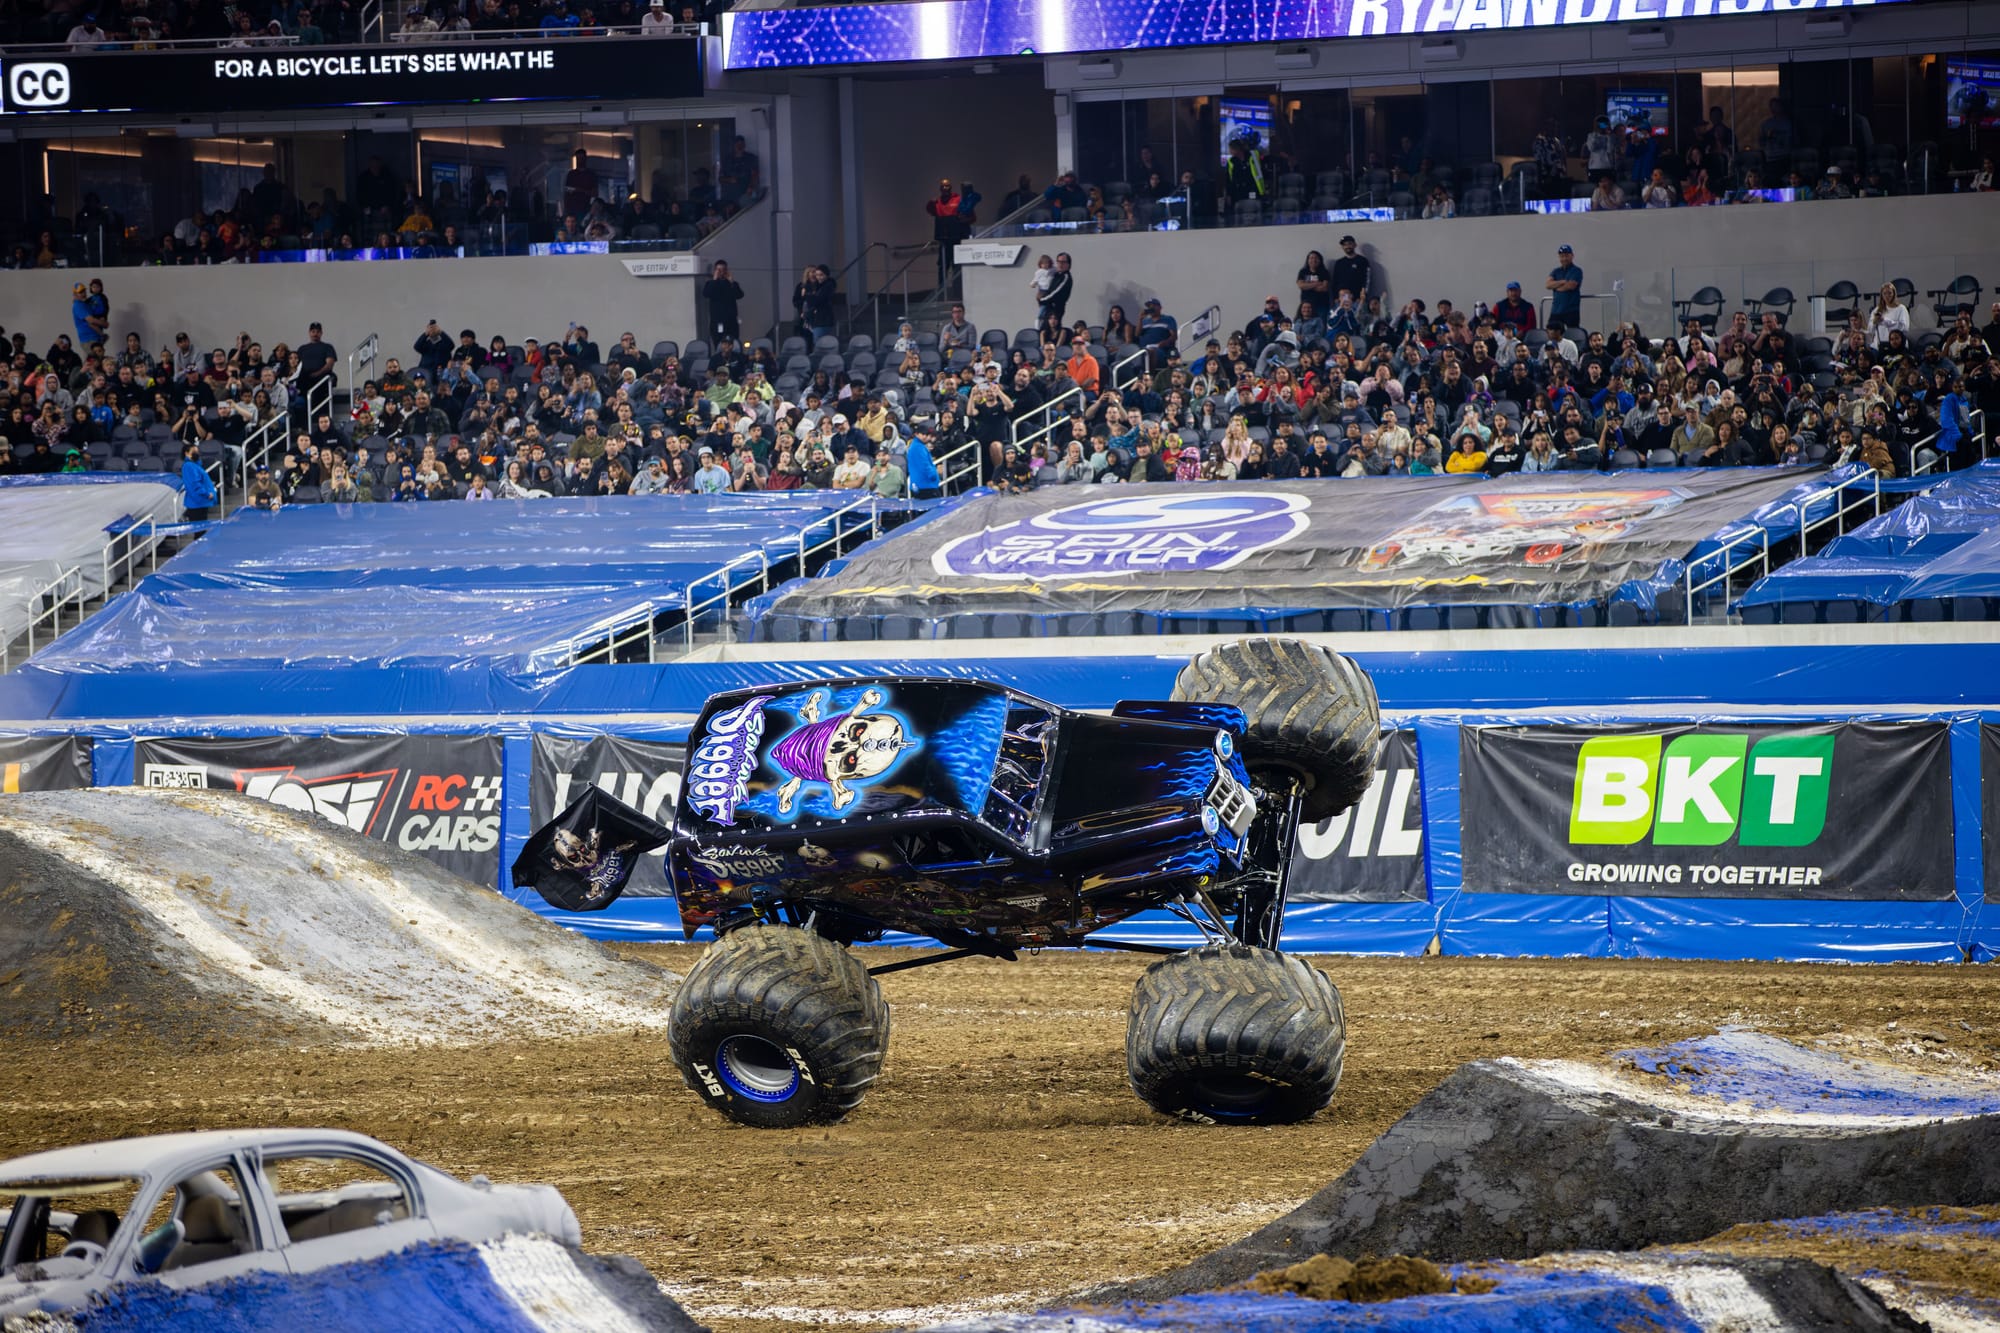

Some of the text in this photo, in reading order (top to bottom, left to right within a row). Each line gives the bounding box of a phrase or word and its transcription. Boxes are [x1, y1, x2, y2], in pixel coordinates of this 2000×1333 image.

[215, 50, 555, 78] FOR A BICYCLE. LET'S SEE WHAT HE
[16, 69, 65, 101] CC
[631, 263, 644, 272] VIP
[646, 263, 668, 272] ENTRY
[971, 546, 1209, 565] MASTER
[1000, 531, 1237, 549] SPIN
[690, 697, 766, 823] Digger
[409, 775, 466, 811] RC
[1577, 756, 1824, 824] BKT
[399, 815, 501, 852] CARS
[692, 855, 784, 878] Digger
[1567, 863, 1822, 886] GROWING TOGETHER
[692, 1062, 725, 1097] BKT
[786, 1047, 815, 1085] BKT
